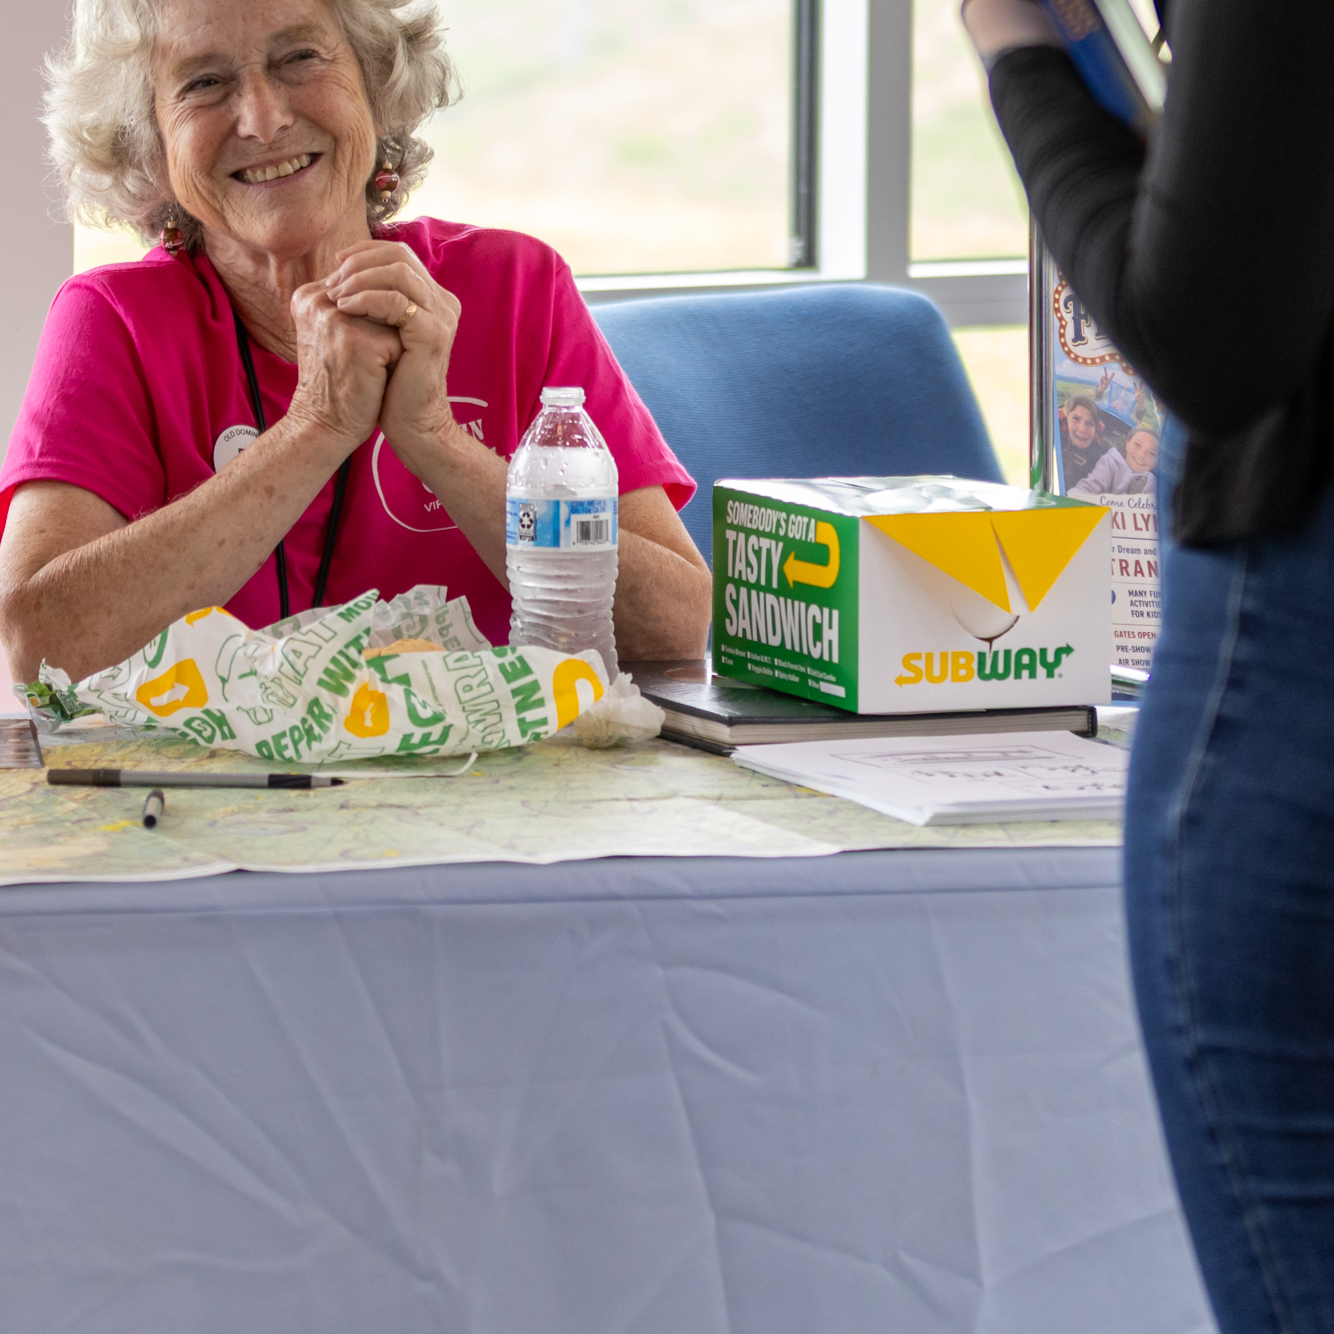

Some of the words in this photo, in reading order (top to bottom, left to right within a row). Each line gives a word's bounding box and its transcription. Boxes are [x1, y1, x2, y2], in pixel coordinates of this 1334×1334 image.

[223, 430, 236, 443] OLD
[1100, 495, 1125, 508] Come
[726, 500, 787, 537] SOMEBODY'S
[787, 514, 808, 542] GOT
[807, 518, 816, 544] A
[1117, 545, 1141, 555] Dream
[1143, 547, 1157, 556] and
[725, 529, 784, 590] TASTY
[1128, 590, 1147, 598] MANY
[1131, 610, 1145, 618] FOR
[725, 583, 840, 664] SANDWICH
[1114, 630, 1136, 639] GATES
[1116, 645, 1152, 654] PRE-SHOW
[894, 643, 1075, 688] SUBWAY
[1118, 658, 1129, 666] AIR
[1131, 658, 1151, 667] SHOW
